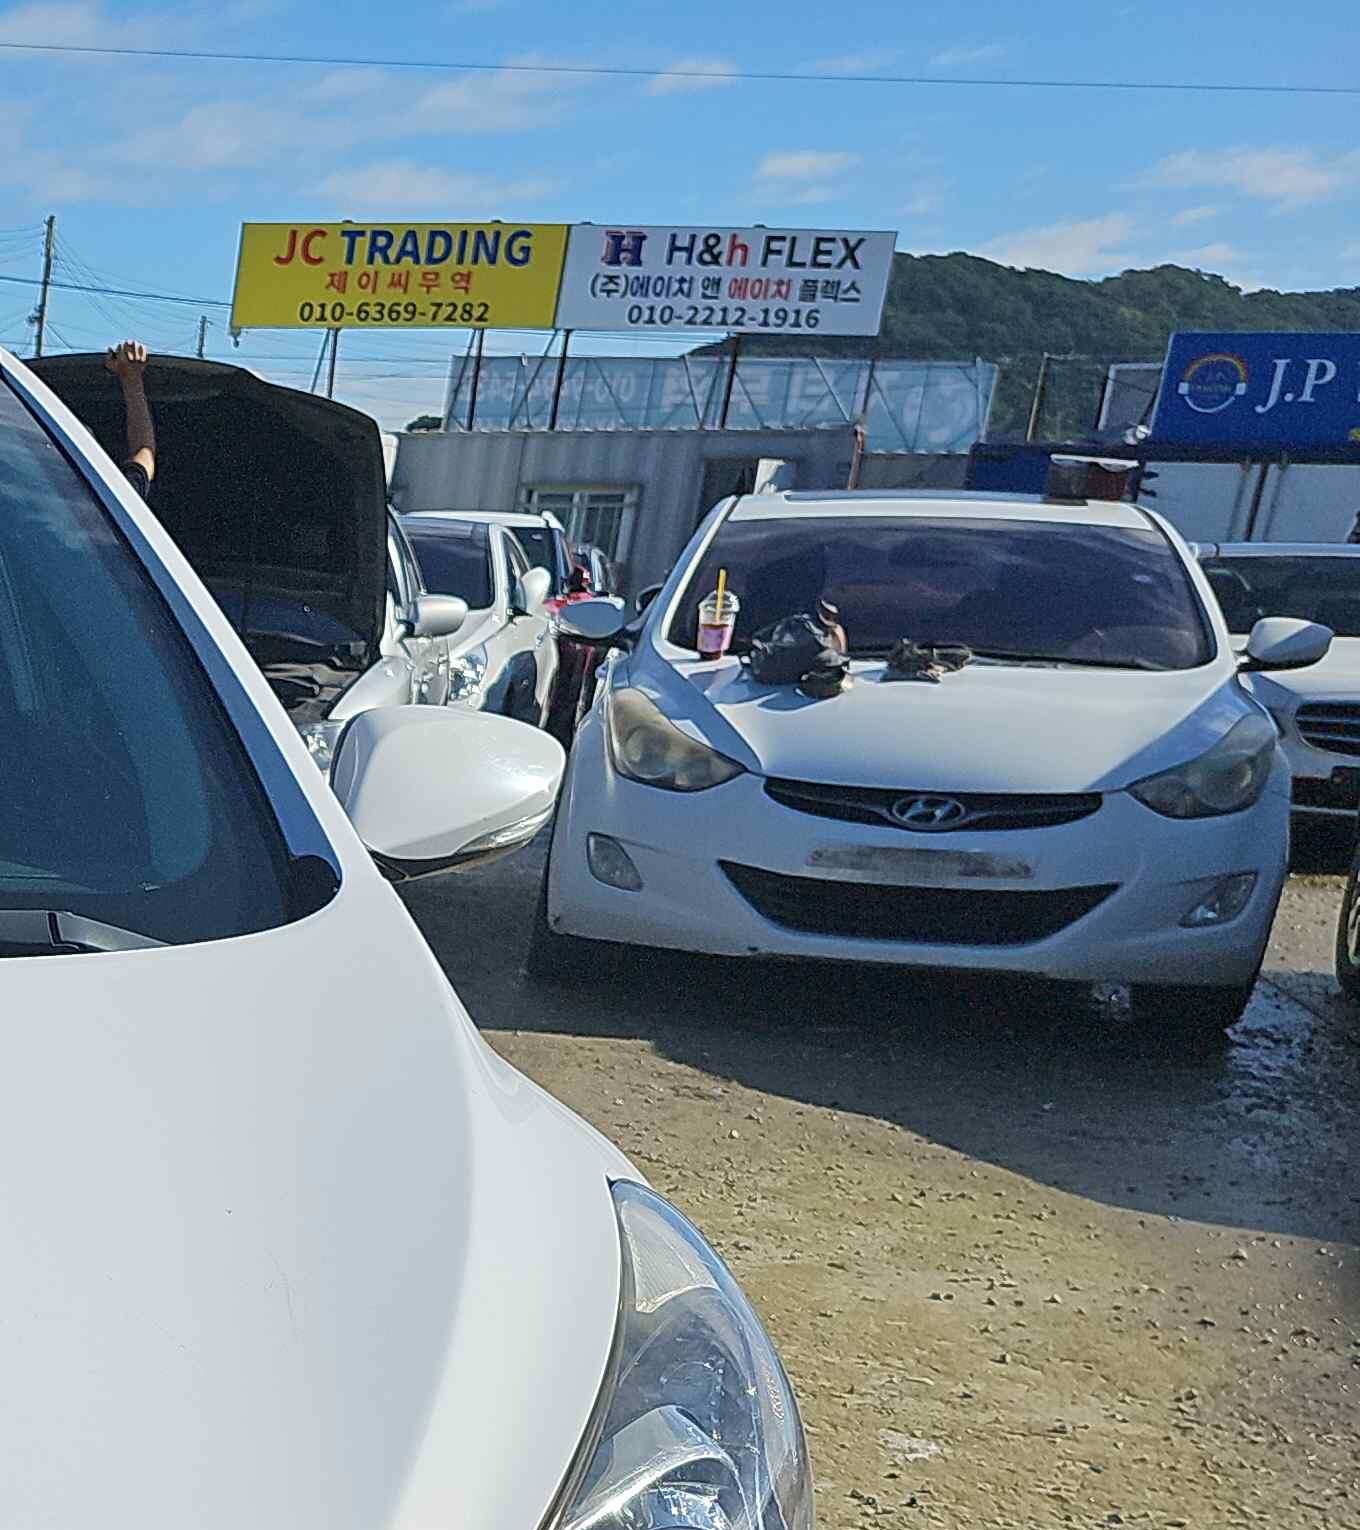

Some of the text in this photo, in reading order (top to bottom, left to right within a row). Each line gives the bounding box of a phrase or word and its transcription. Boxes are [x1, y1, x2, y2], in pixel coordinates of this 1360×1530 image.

[273, 229, 534, 266] JC TRADING
[666, 233, 749, 268] H&h
[760, 235, 867, 270] FLEX
[728, 277, 792, 301] 에이치
[798, 279, 862, 303] 플렉스
[299, 302, 490, 323] 010-6369-7282
[627, 305, 822, 329] 010-2212-1916
[1254, 358, 1338, 413] J.P
